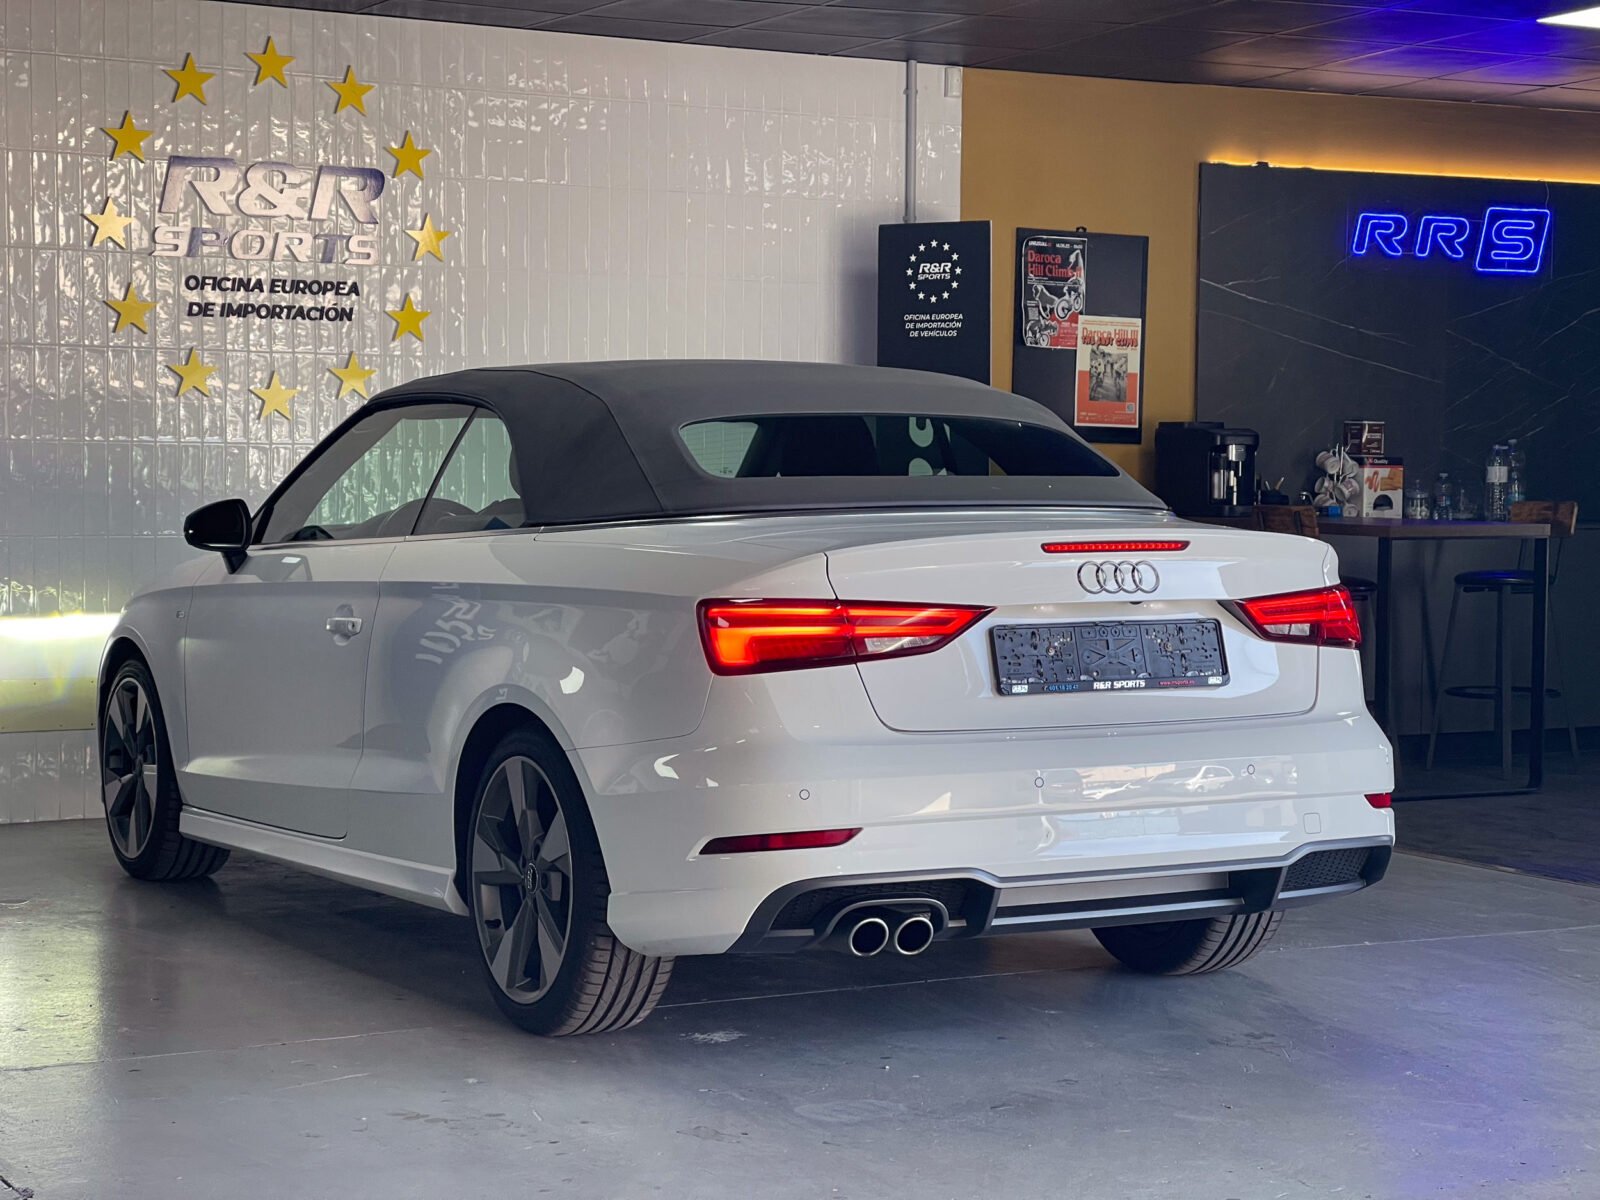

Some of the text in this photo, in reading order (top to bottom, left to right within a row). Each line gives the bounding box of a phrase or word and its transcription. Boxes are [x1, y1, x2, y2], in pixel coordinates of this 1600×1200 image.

[159, 156, 385, 224] R&R
[150, 226, 379, 265] SPORTS
[1028, 250, 1062, 264] Daroca
[919, 262, 952, 273] R&R
[1028, 263, 1044, 276] Hill
[185, 275, 360, 296] OFICINA EUROPEA
[187, 302, 353, 321] DE IMPORTACIÓN
[920, 329, 957, 337] VEHÍCULOS
[1113, 680, 1146, 688] SPORTS
